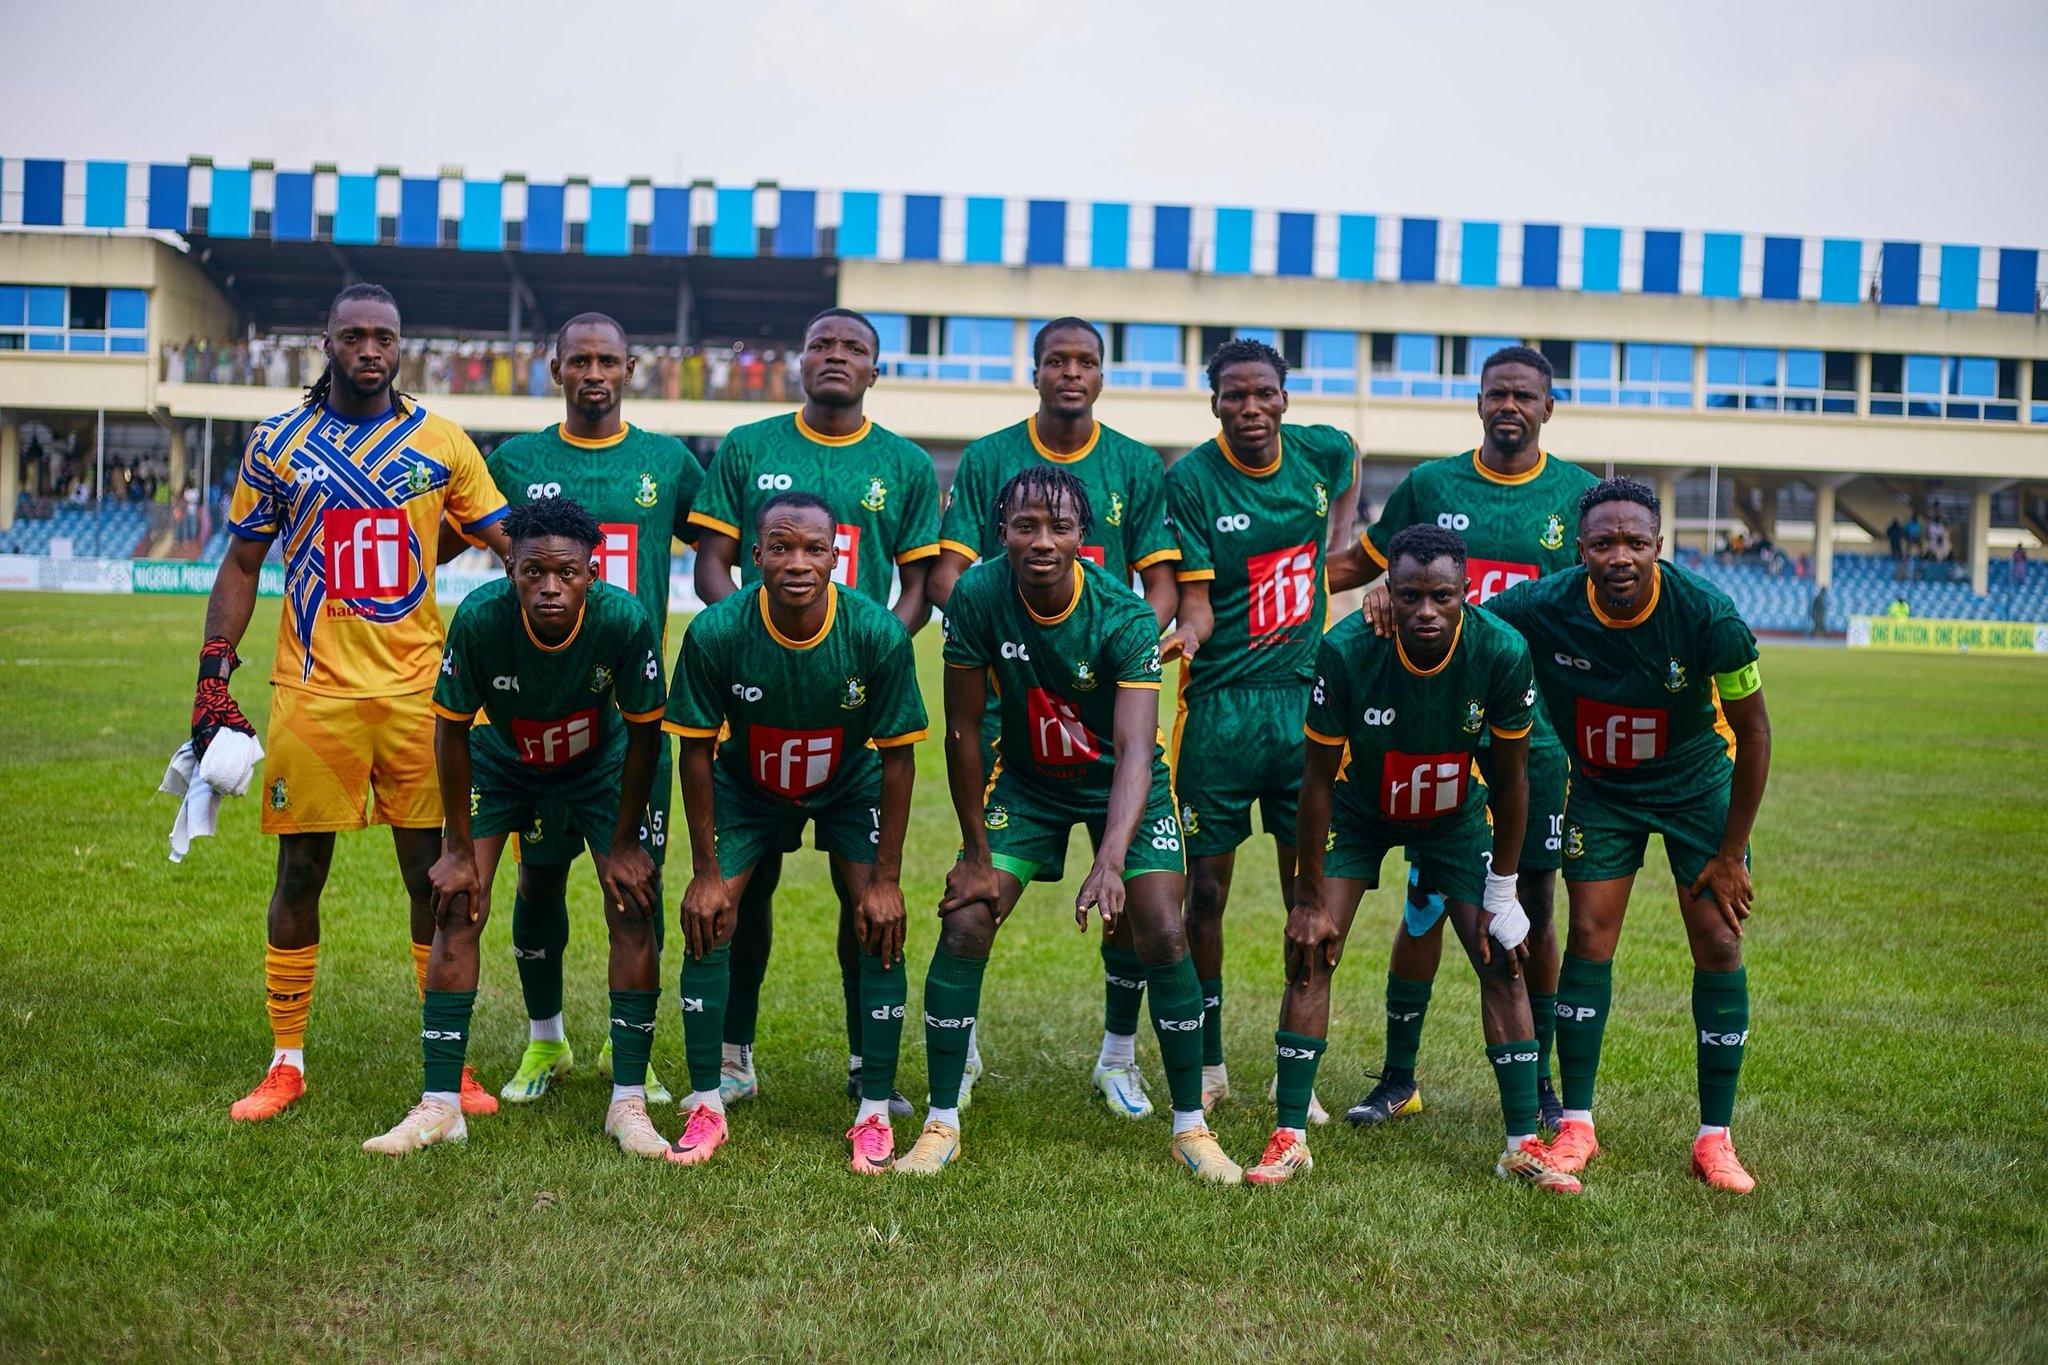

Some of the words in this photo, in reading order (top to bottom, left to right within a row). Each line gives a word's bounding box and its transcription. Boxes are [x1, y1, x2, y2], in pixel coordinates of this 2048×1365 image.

[757, 474, 793, 491] ao
[1216, 513, 1251, 533] ao
[1437, 513, 1470, 531] ao
[333, 517, 399, 590] rfi
[1258, 552, 1312, 627] rfi
[1739, 666, 1758, 692] C
[1363, 707, 1396, 726] ao
[523, 717, 590, 763] rfi
[1586, 714, 1656, 765] rfi
[760, 736, 833, 790] rfi
[1390, 763, 1459, 815] rfi
[1152, 816, 1177, 836] 30
[1151, 836, 1179, 851] ao
